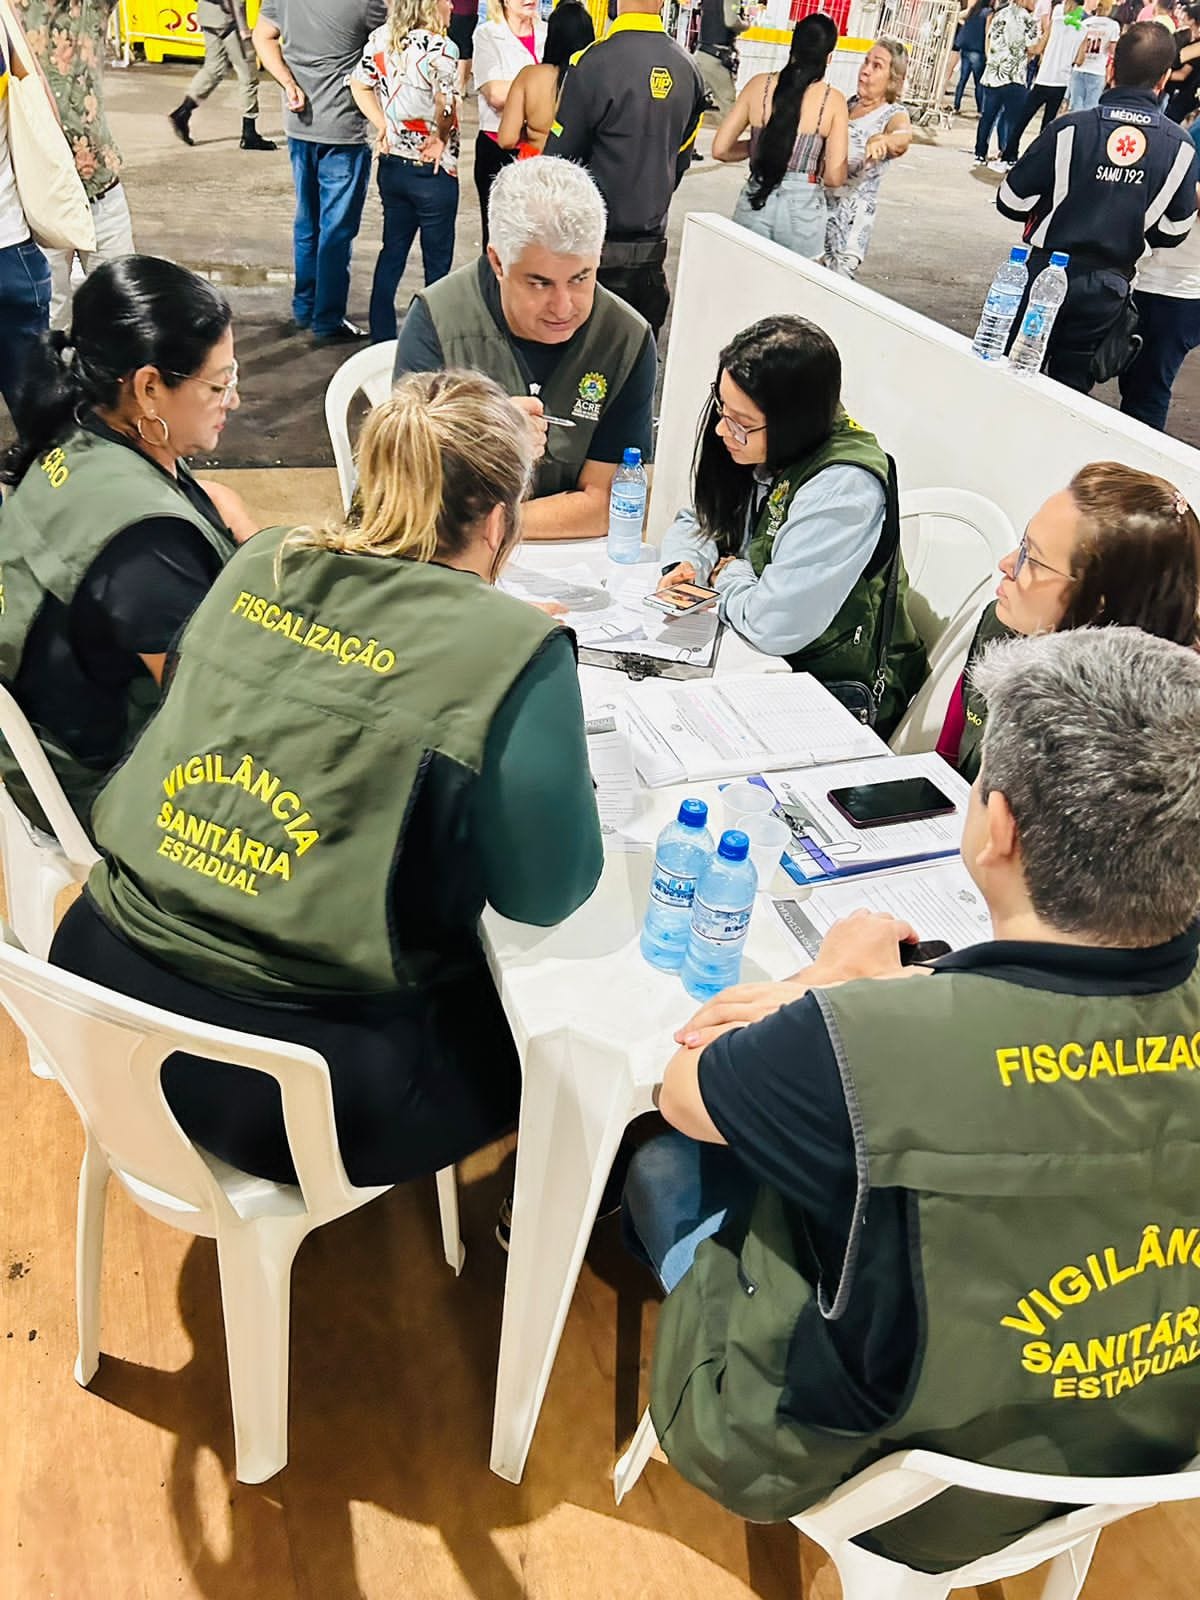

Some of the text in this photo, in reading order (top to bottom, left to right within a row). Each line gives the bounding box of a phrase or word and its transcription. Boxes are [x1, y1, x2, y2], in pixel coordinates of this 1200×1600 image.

[1110, 109, 1152, 124] MÉDICO
[1095, 165, 1145, 184] SAMU 192
[573, 399, 601, 414] ACRE
[232, 592, 396, 673] FISCALIZAÇÃO
[162, 753, 320, 857] VIGILÂNCIA
[156, 801, 293, 881] SANITÁRIA
[157, 836, 260, 897] ESTADUAL
[1021, 1306, 1200, 1376] SANITÁR
